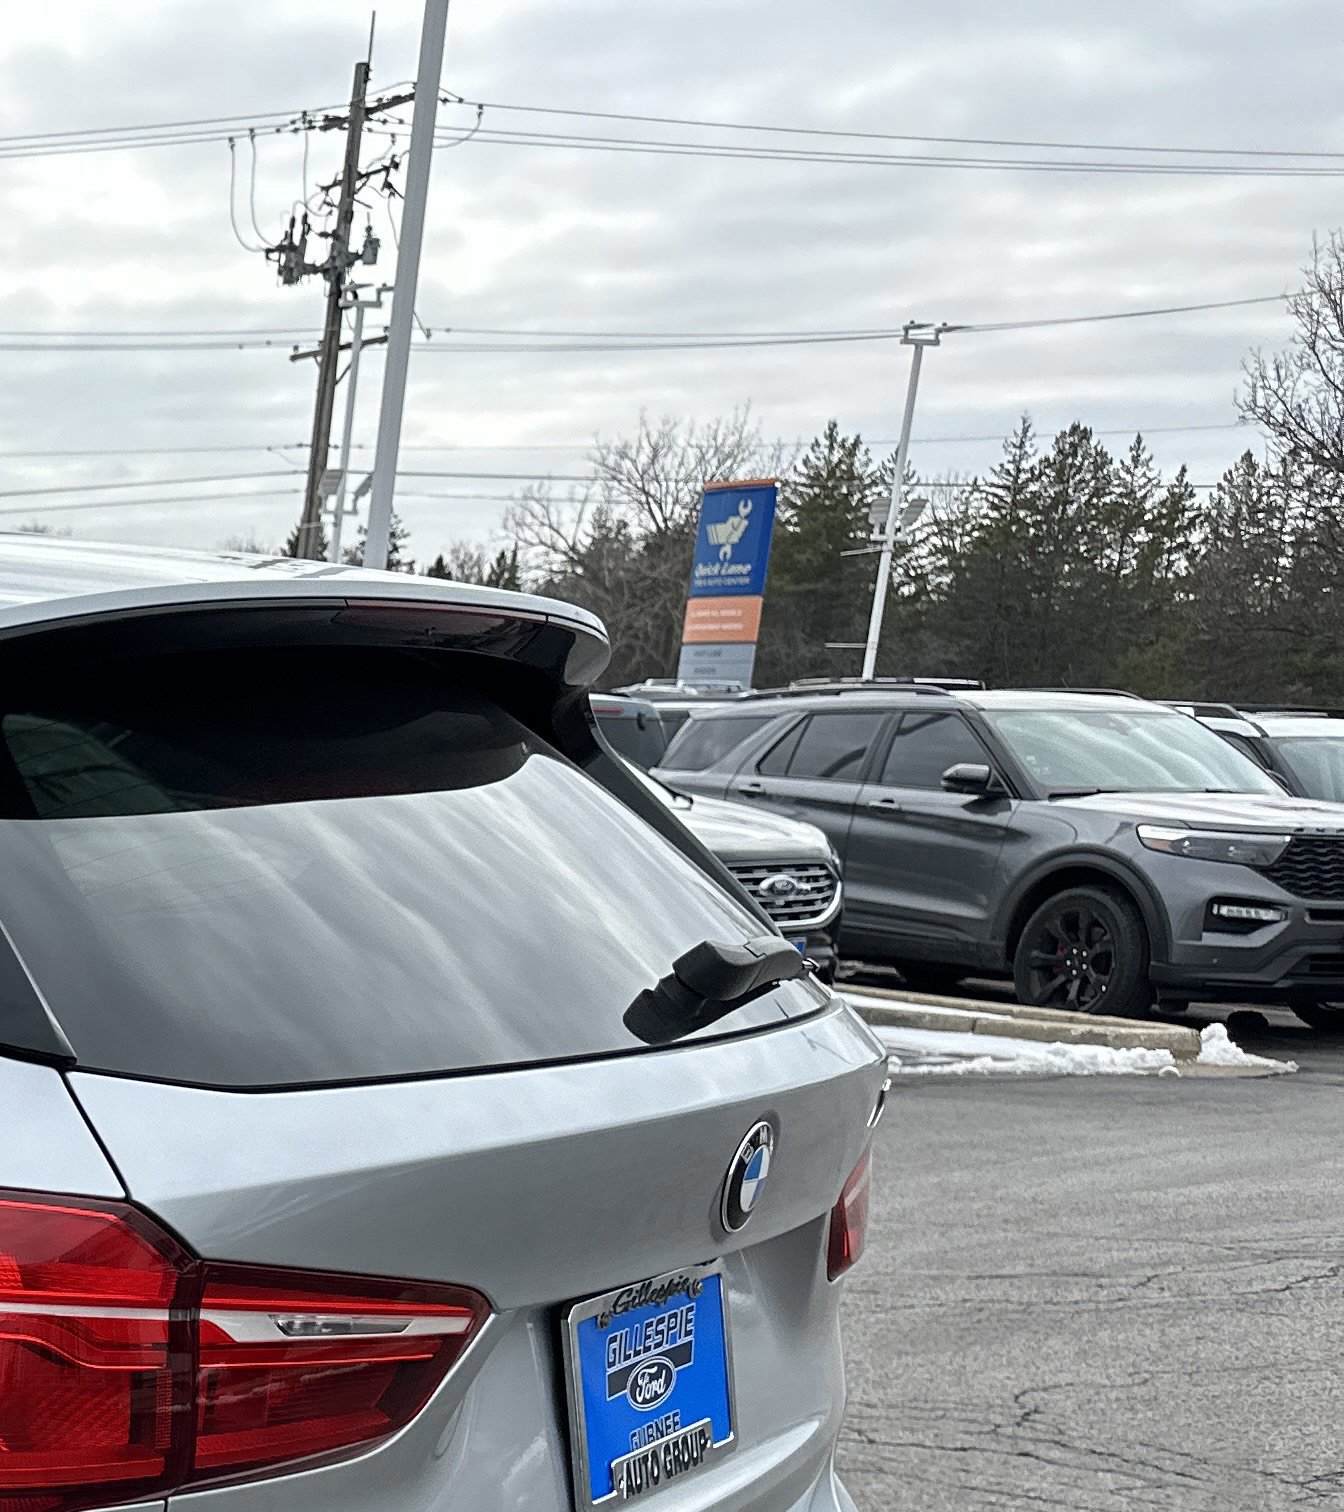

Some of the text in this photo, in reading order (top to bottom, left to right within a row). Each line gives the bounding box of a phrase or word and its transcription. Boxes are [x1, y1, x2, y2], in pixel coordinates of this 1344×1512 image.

[611, 1275, 690, 1316] Gillespie
[606, 1302, 696, 1372] GILLESPIE
[635, 1366, 667, 1403] Ford
[629, 1409, 681, 1451] GURNEE
[620, 1428, 712, 1499] AUTO GROUP
